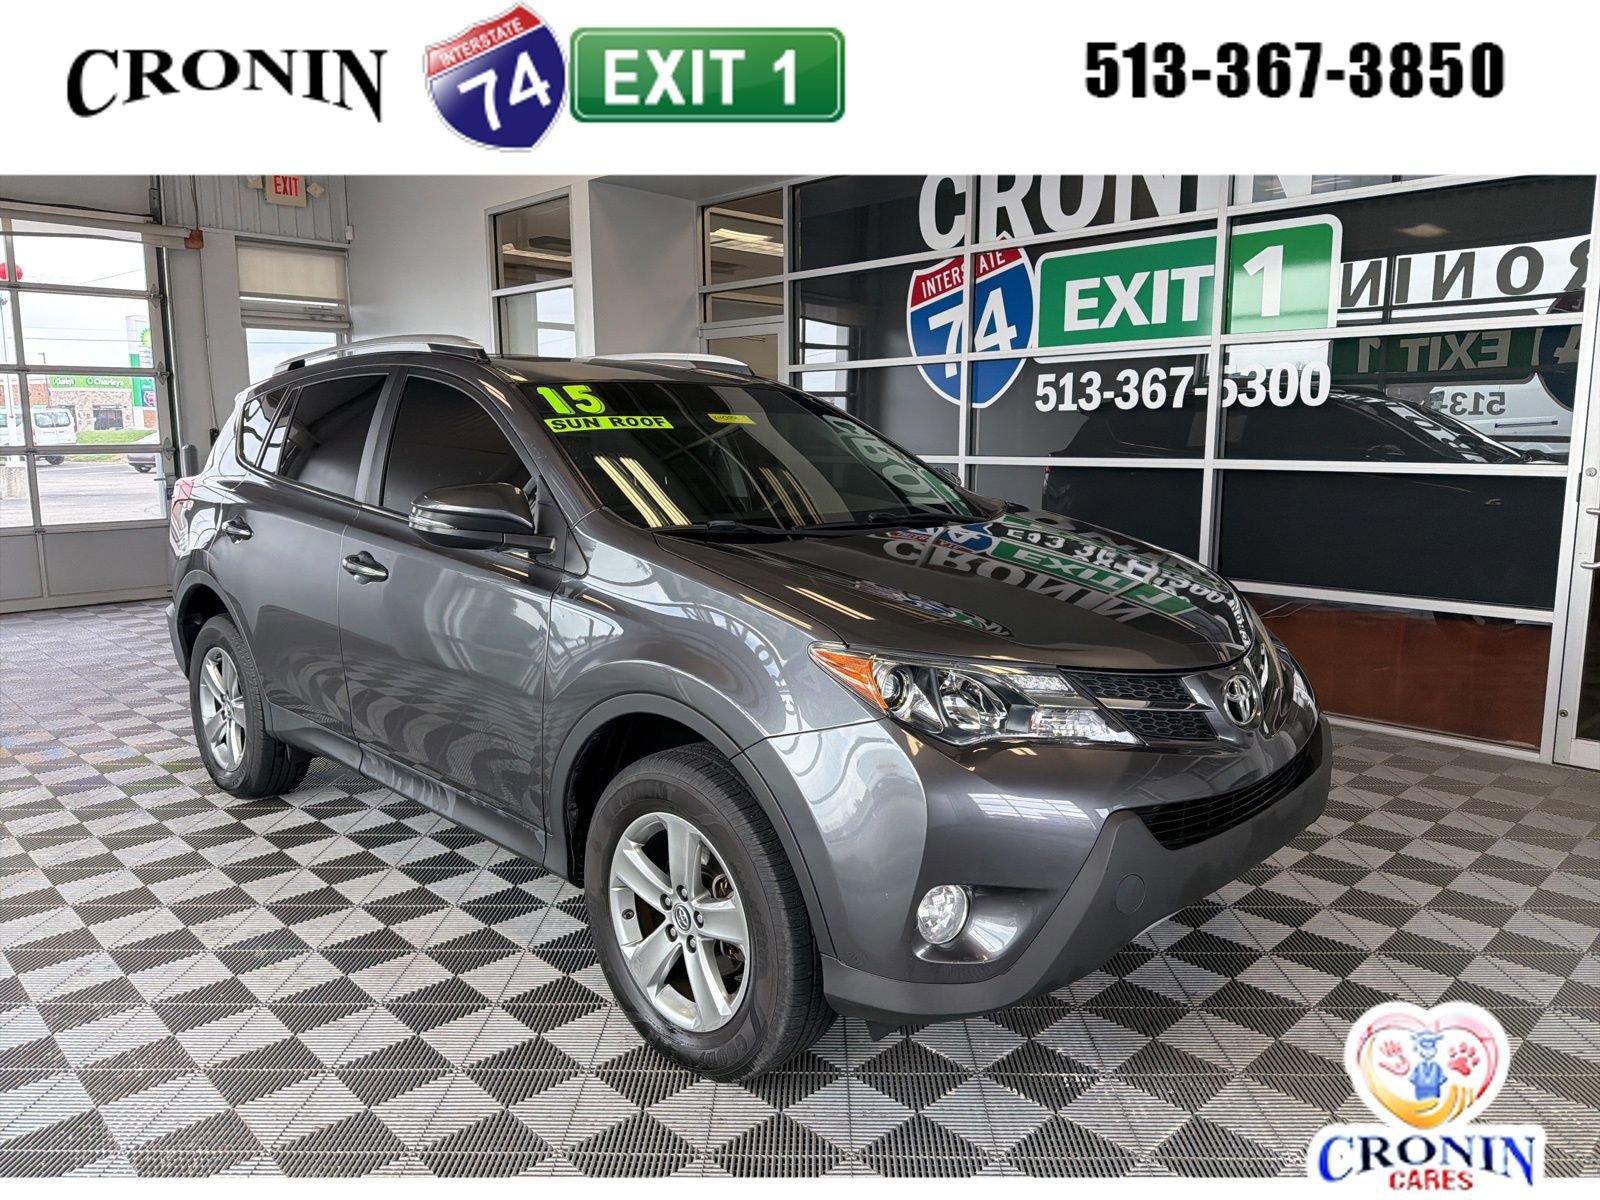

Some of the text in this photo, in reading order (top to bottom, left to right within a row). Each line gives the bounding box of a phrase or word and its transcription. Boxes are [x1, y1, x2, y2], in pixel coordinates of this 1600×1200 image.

[273, 175, 299, 197] EXIT
[919, 174, 1312, 250] CRON
[921, 251, 1006, 299] INTERATE
[1063, 245, 1284, 332] EXIT 1
[928, 287, 1018, 379] 74
[536, 385, 606, 415] 15
[551, 417, 667, 430] SUN ROOF
